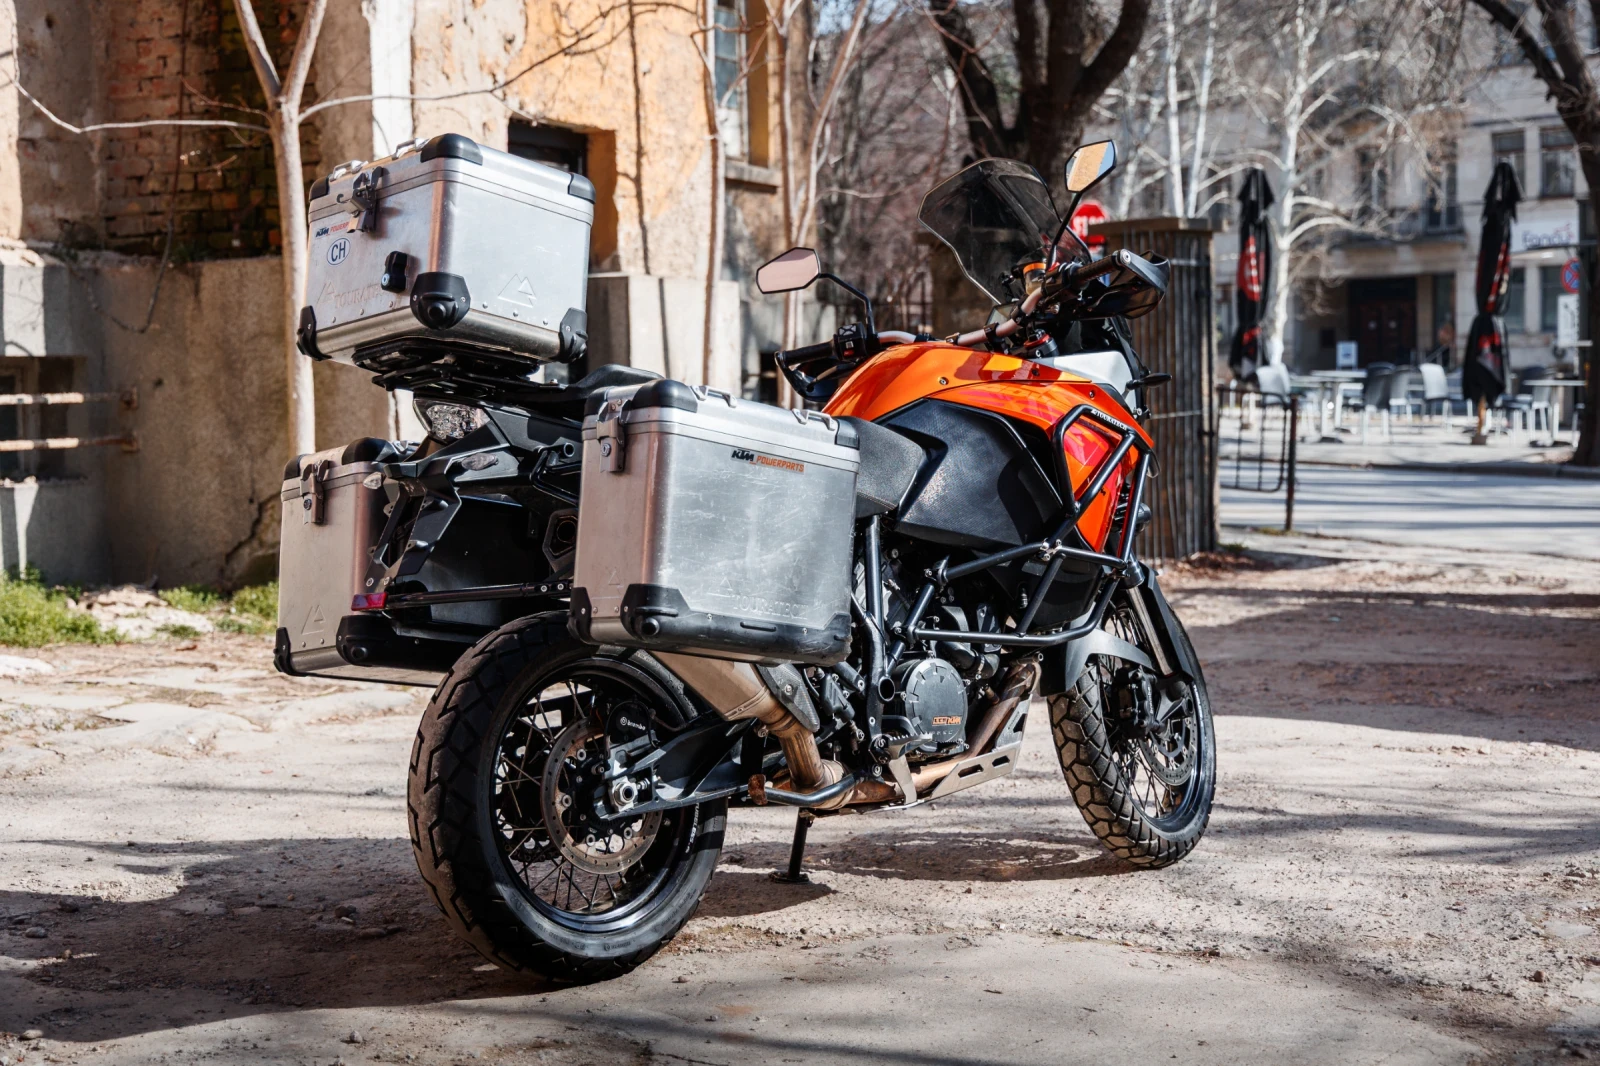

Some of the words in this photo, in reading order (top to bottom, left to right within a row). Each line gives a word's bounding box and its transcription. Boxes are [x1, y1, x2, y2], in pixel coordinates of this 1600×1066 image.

[331, 240, 346, 262] CH
[731, 449, 755, 462] KTM
[756, 455, 804, 473] POWERPARTS
